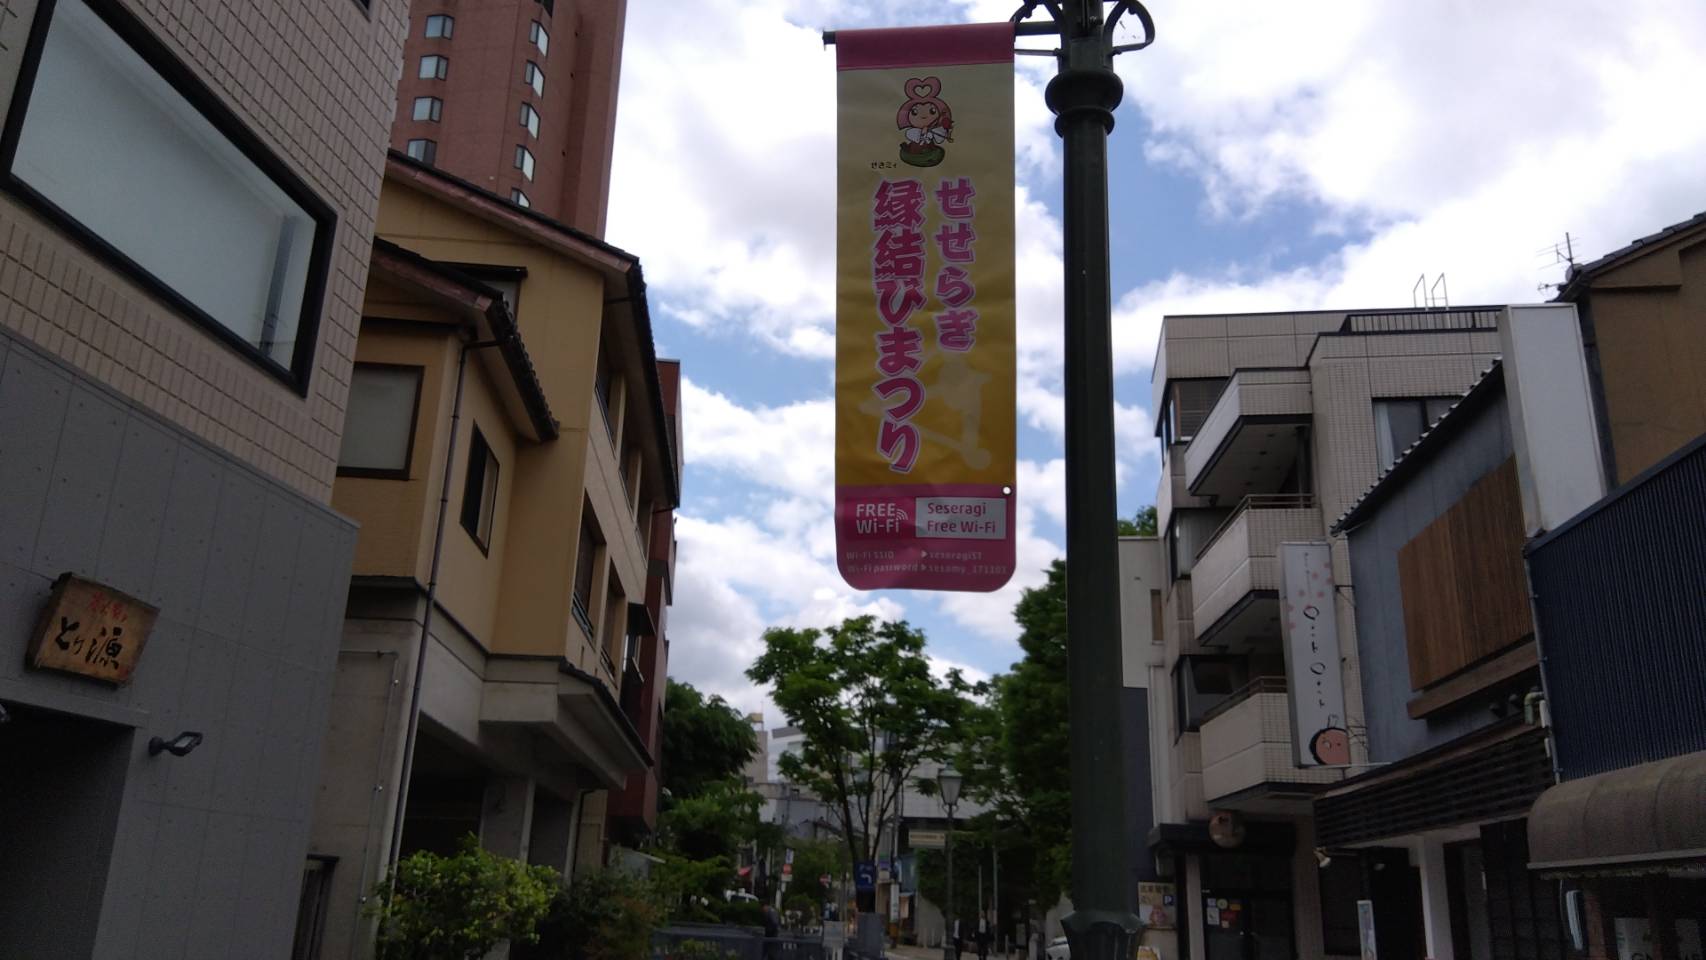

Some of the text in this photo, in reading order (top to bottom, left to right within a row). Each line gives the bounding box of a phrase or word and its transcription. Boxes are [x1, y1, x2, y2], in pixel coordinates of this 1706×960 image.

[935, 178, 977, 351] せせらぎ
[873, 179, 926, 472] 縁結びまつり
[856, 502, 896, 517] FREE
[928, 502, 986, 516] Seseragi
[856, 518, 899, 534] Wi-Fi
[927, 520, 996, 533] Free Wi-Fi
